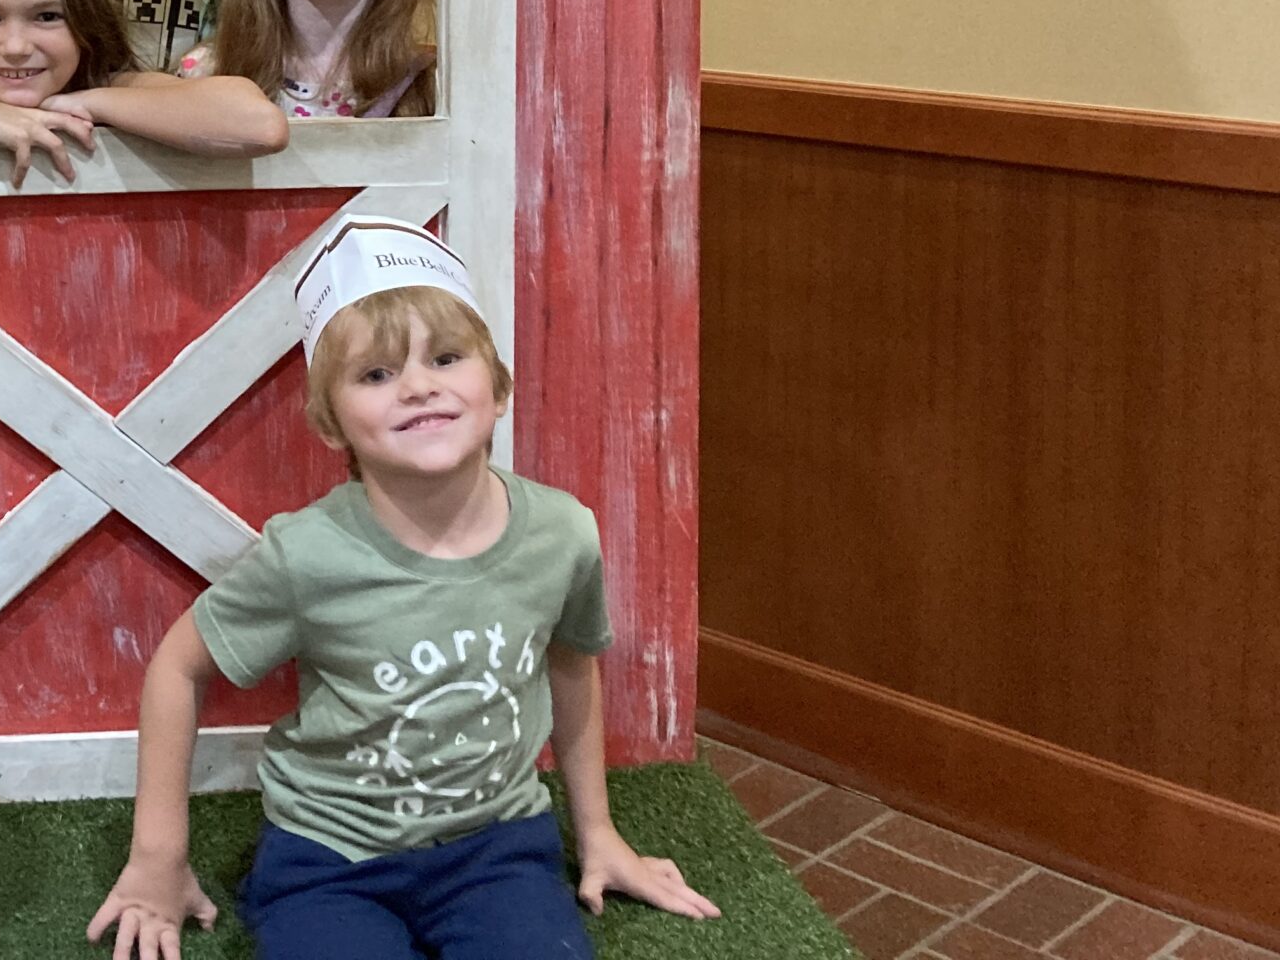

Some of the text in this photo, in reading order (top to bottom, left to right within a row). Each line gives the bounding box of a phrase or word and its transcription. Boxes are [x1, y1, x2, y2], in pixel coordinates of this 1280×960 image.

[374, 253, 453, 279] Blue Bell
[373, 622, 536, 694] earth
